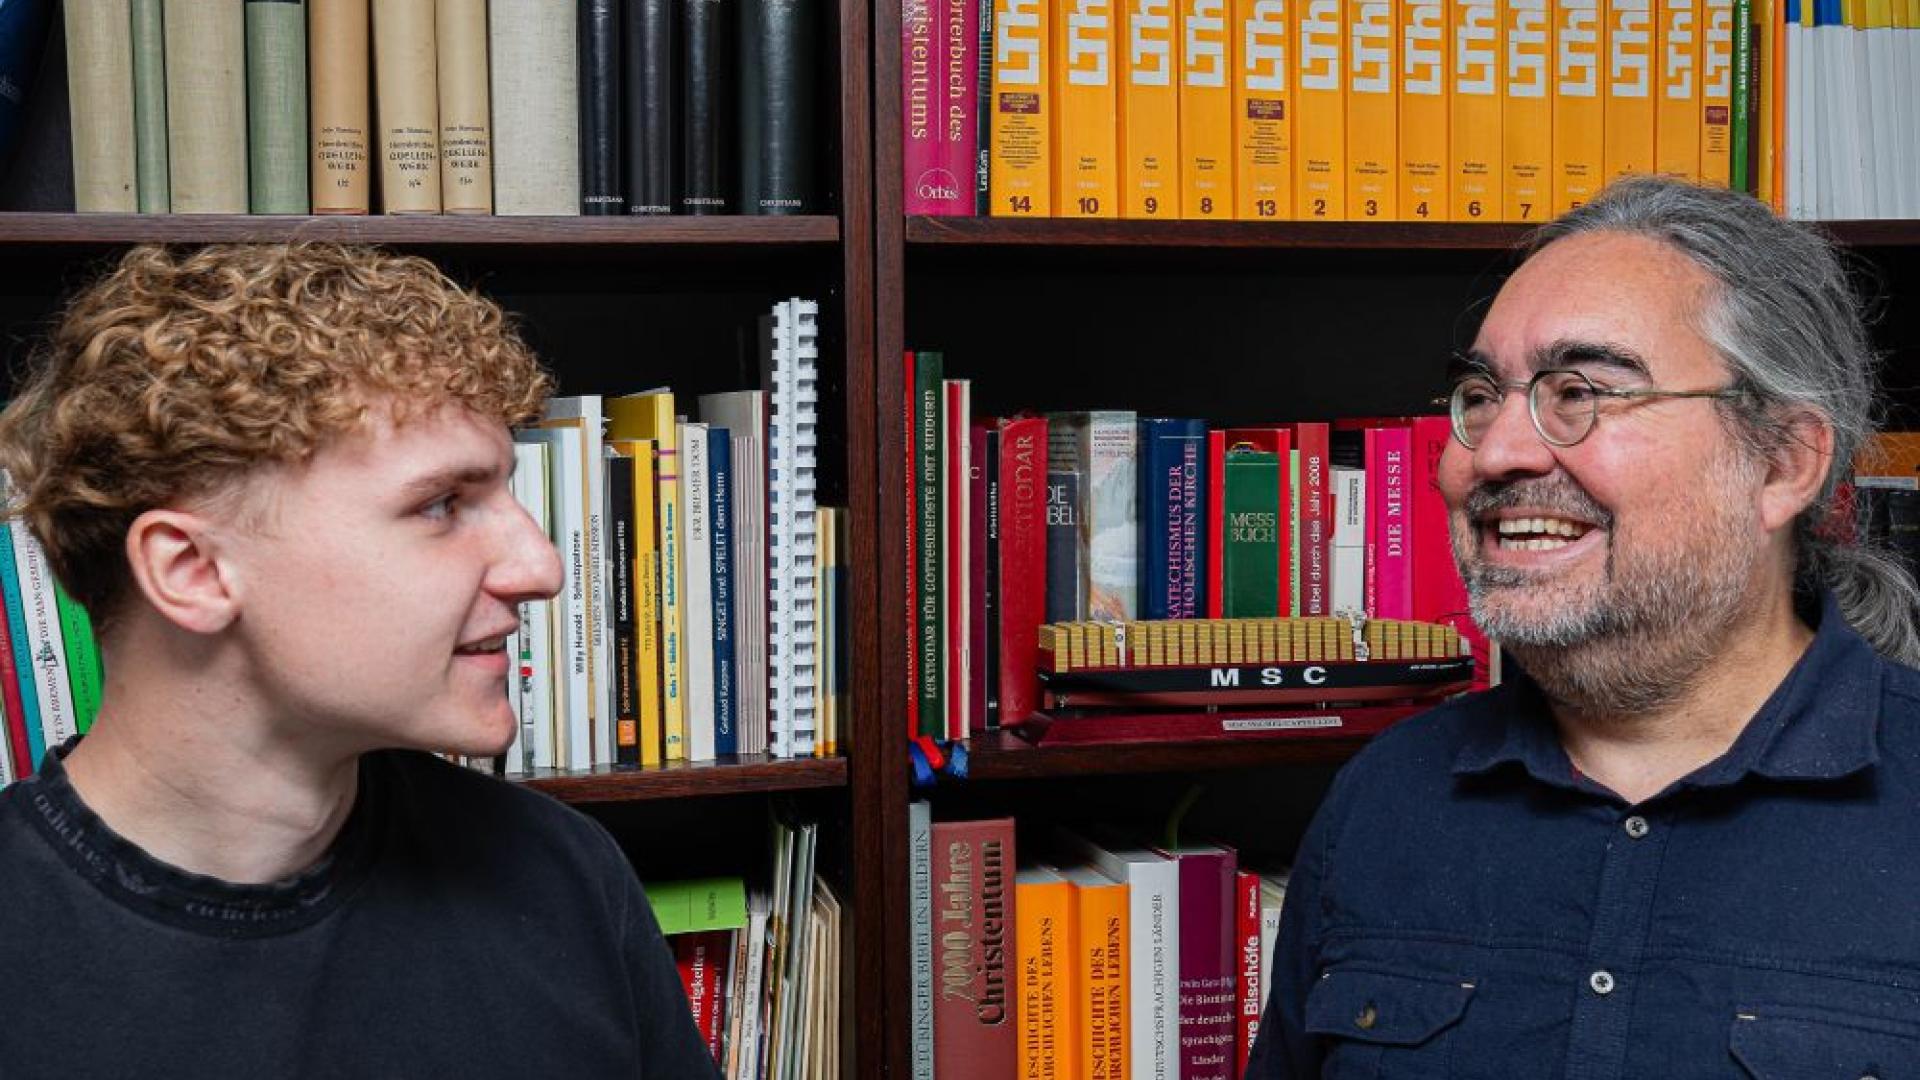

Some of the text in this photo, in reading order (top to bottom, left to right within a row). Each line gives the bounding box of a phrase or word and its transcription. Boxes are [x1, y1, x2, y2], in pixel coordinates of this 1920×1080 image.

[911, 0, 933, 139] ristentums
[1352, 0, 1390, 93] LTh
[1404, 0, 1442, 95] LTh
[1456, 0, 1496, 95] LTh
[1508, 0, 1546, 97] LTh
[1559, 0, 1597, 97] LTh
[1611, 0, 1649, 97] LTh
[1667, 0, 1692, 98] LTh
[1705, 0, 1729, 97] LTh
[949, 106, 967, 142] des
[918, 185, 959, 200] Orbis
[1009, 195, 1032, 213] 14
[1079, 197, 1099, 214] 10
[1145, 198, 1157, 214] 9
[1202, 198, 1213, 214] 8
[1256, 200, 1276, 216] 13
[1314, 200, 1326, 216] 2
[1366, 200, 1378, 217] 3
[1416, 201, 1429, 218] 4
[1468, 201, 1481, 217] 6
[1520, 203, 1532, 219] 7
[924, 389, 936, 451] KINDERN
[690, 439, 702, 541] DER BREMER DOM
[924, 454, 936, 482] MIT
[1015, 435, 1034, 550] EKTIONAR
[1168, 465, 1182, 500] DER
[1046, 505, 1076, 525] BEL
[1183, 443, 1197, 618] HOLISCHEN KIRCHE
[1307, 456, 1321, 614] Bibel durch das Jahr 2008
[1387, 450, 1402, 557] DIE MESSE
[716, 471, 728, 641] SINGET und SPIELET dem Herrn
[924, 485, 936, 592] GOTTESDIENSTE
[34, 593, 46, 618] MAN
[922, 594, 936, 621] FÜR
[46, 669, 61, 711] BREMEN
[574, 650, 586, 674] Willy
[914, 829, 928, 901] BILDERN
[915, 905, 928, 926] IN
[940, 841, 975, 1002] 2000 Jahre
[975, 841, 1007, 1025] Christentum
[1150, 894, 1163, 943] LÄNDER
[916, 930, 929, 974] BIBEL
[1180, 979, 1200, 988] rwin
[1243, 935, 1259, 1016] Bischöfe
[915, 979, 931, 1065] TÜBINGER
[1026, 956, 1040, 1080] ESCHICHTE DES
[1041, 916, 1055, 1080] IRCHLICHEN LEBENS
[1090, 946, 1105, 1080] ESCHICHTE DES
[1107, 916, 1123, 1080] IRCHLICHEN LEBENS
[1192, 1054, 1226, 1065] Länder
